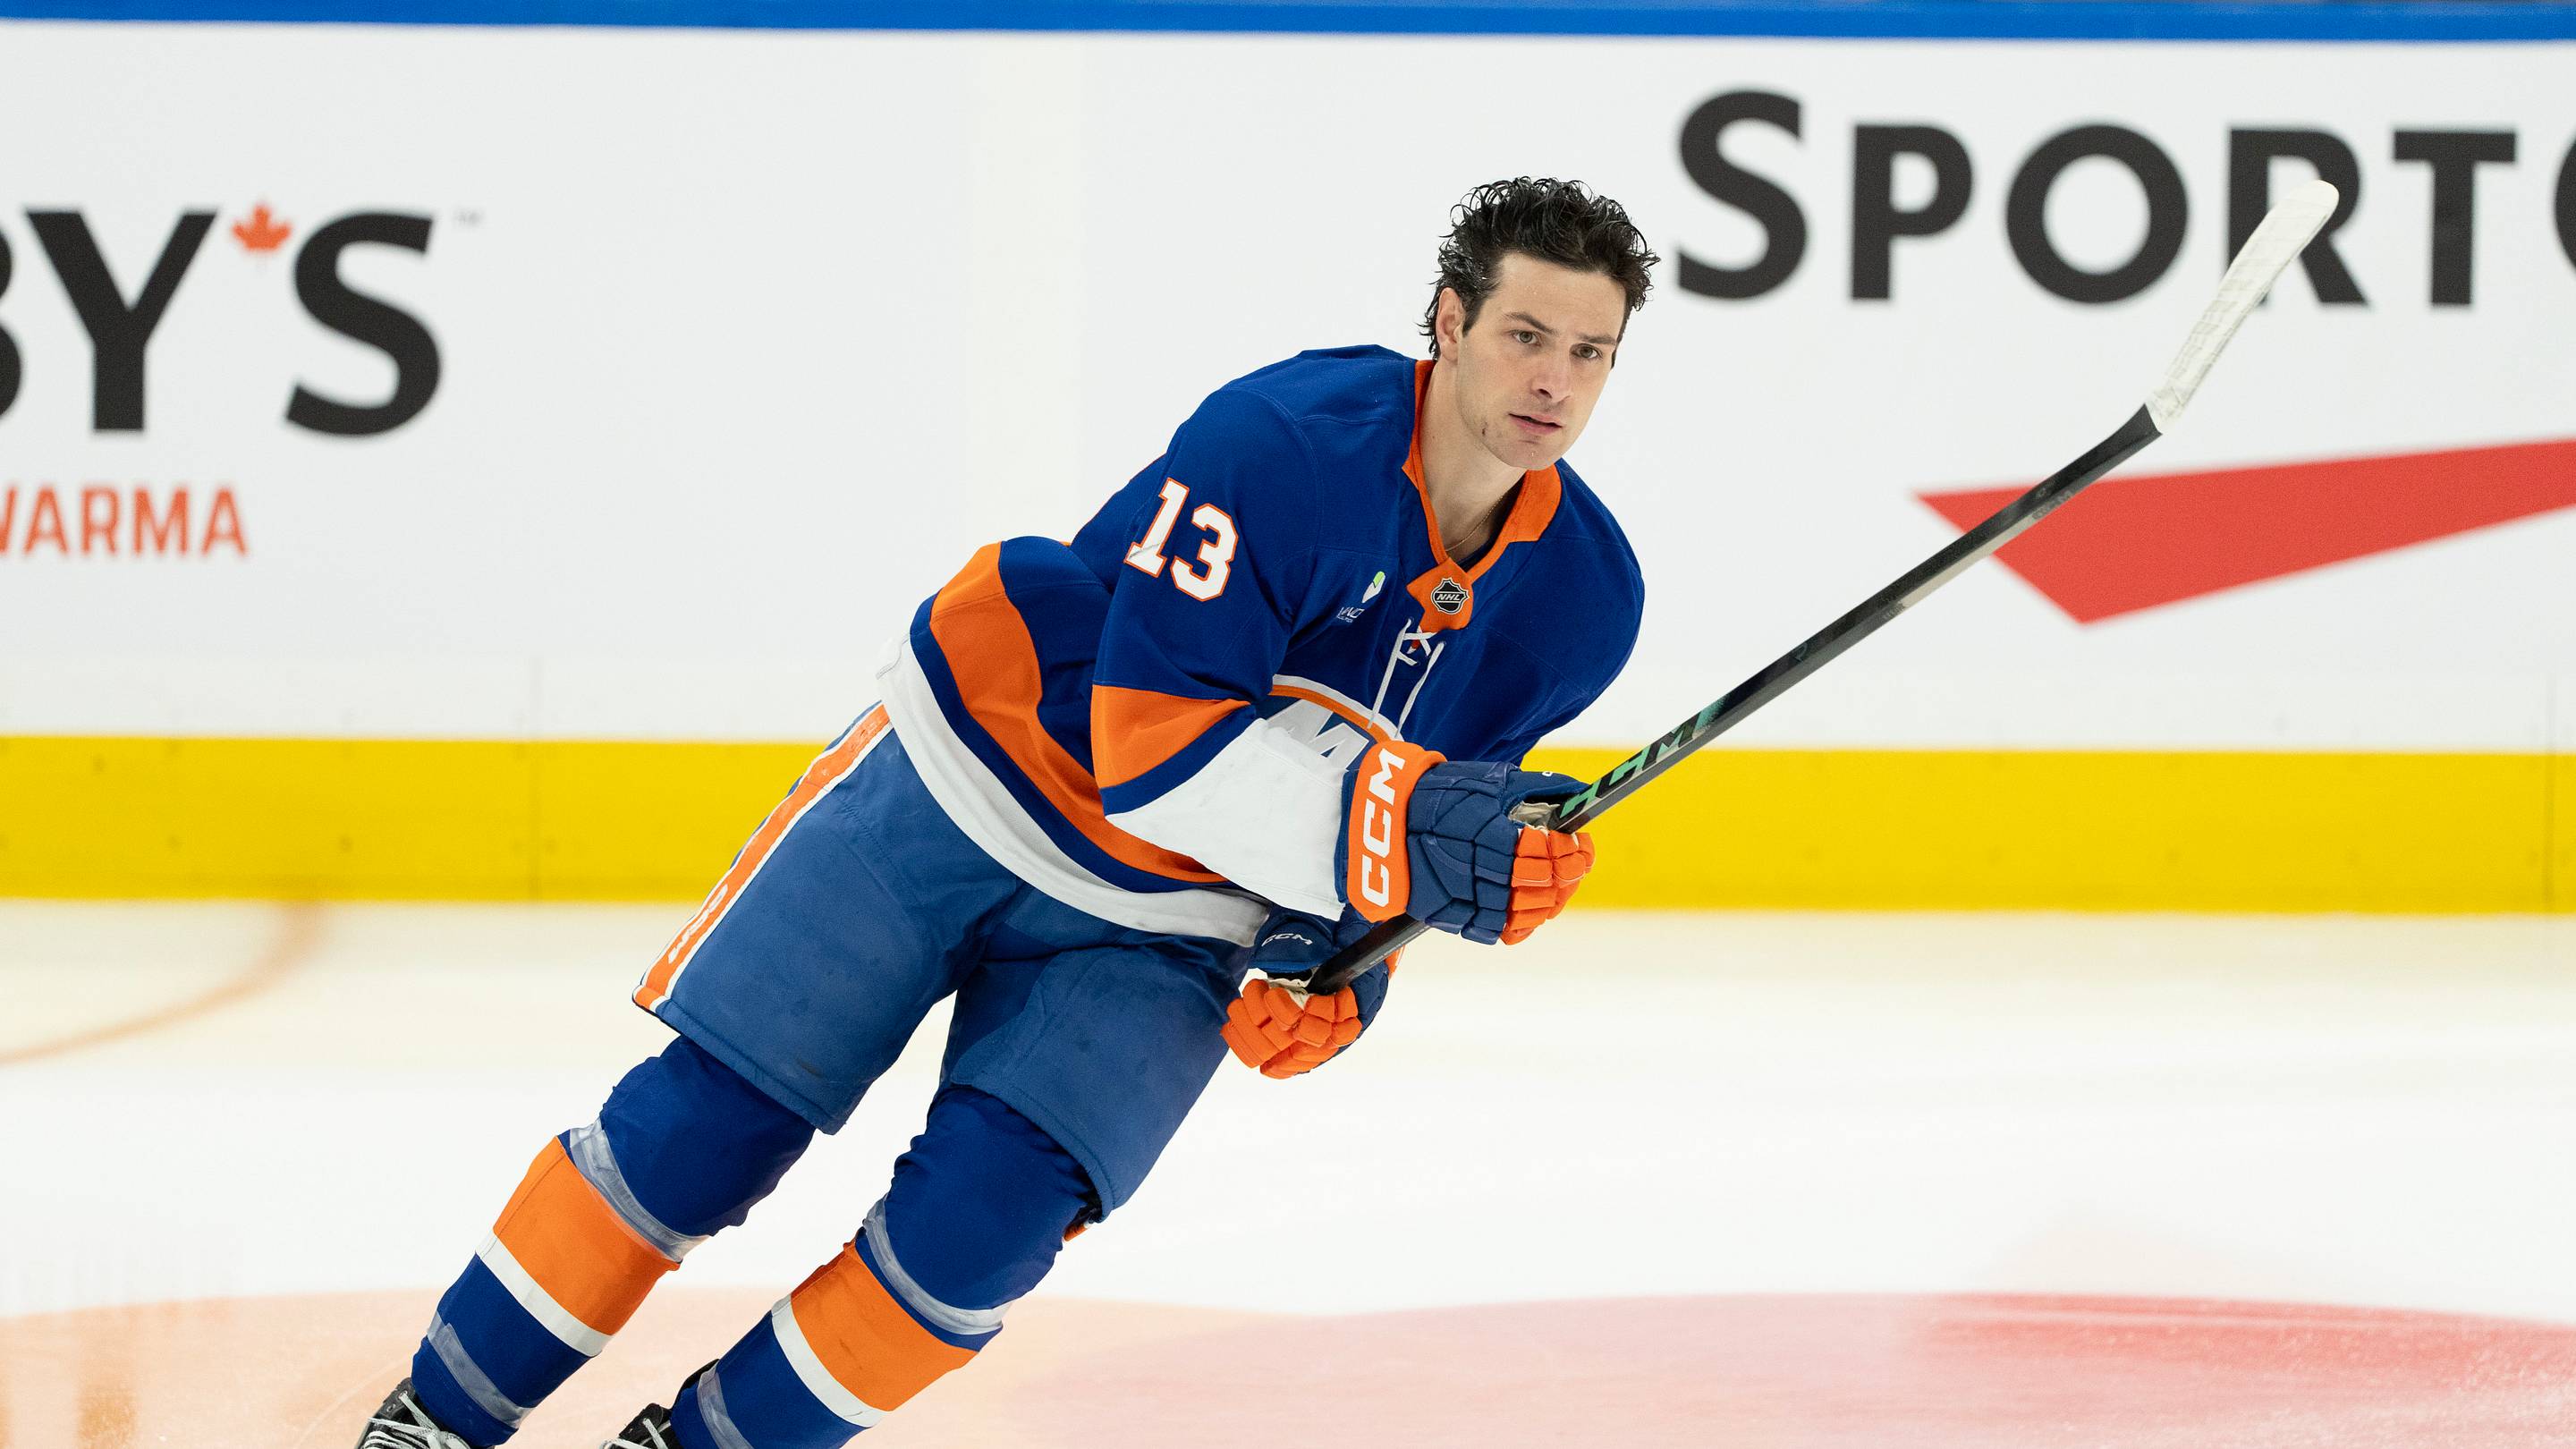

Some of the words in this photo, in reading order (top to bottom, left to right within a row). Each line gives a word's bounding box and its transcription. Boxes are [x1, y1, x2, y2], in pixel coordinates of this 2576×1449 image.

[1676, 89, 2576, 307] SPORT
[1123, 477, 1240, 602] 13
[1436, 593, 1462, 601] NHL
[1361, 748, 1406, 907] CCM
